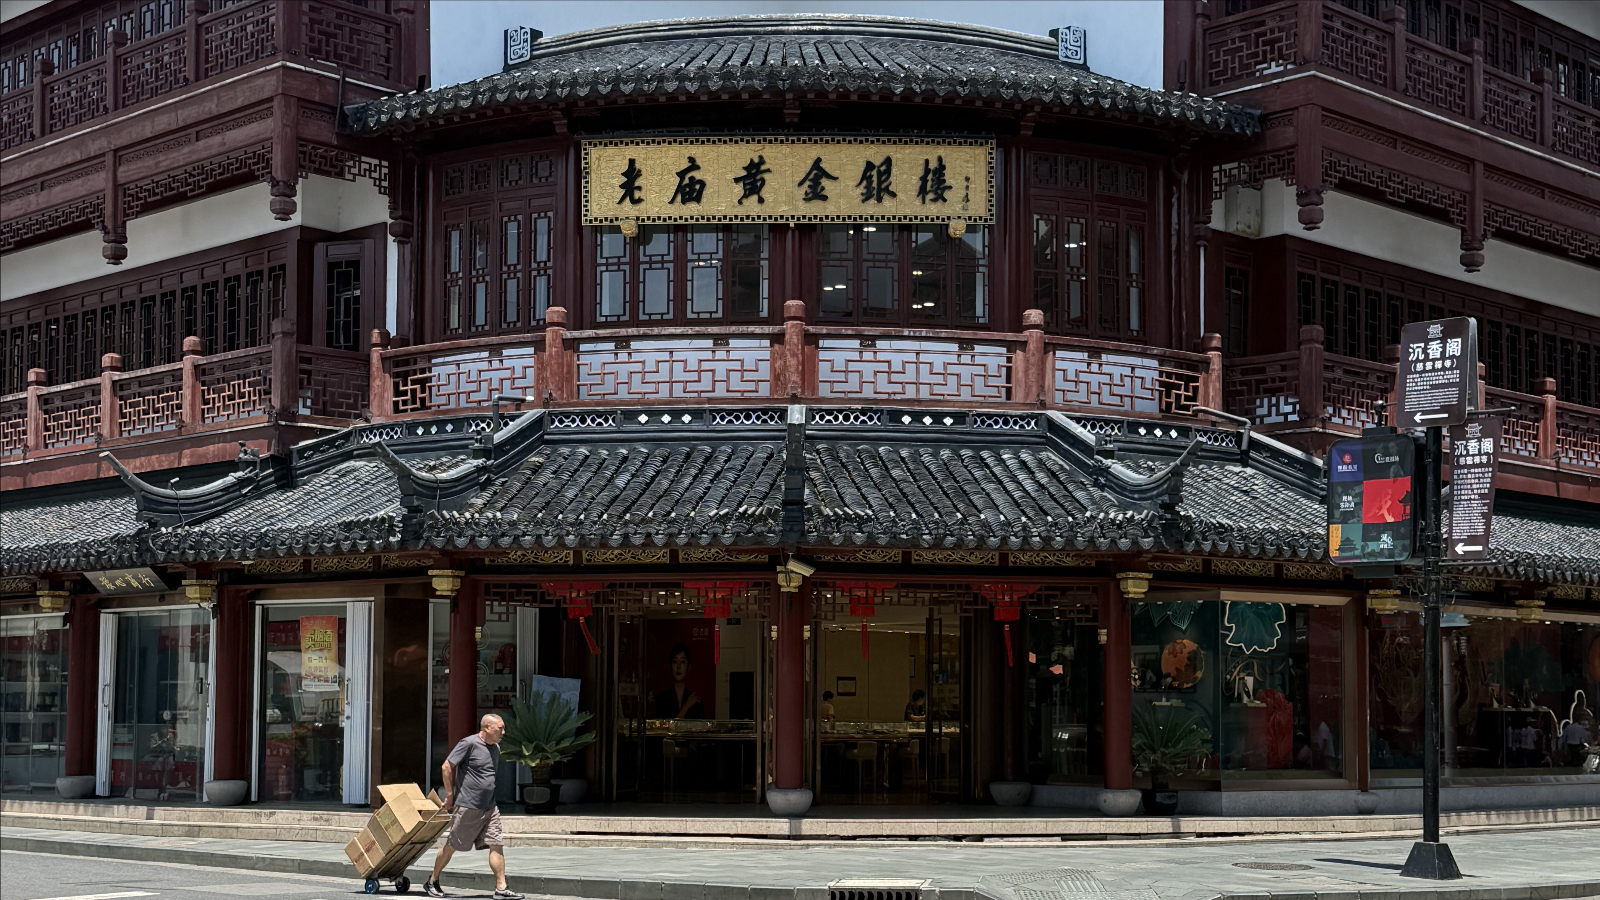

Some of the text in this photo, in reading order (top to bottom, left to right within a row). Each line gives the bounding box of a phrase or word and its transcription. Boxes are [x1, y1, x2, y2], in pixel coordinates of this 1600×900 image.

[1408, 338, 1462, 361] 沉香阁
[1454, 437, 1494, 456] 沉香阁
